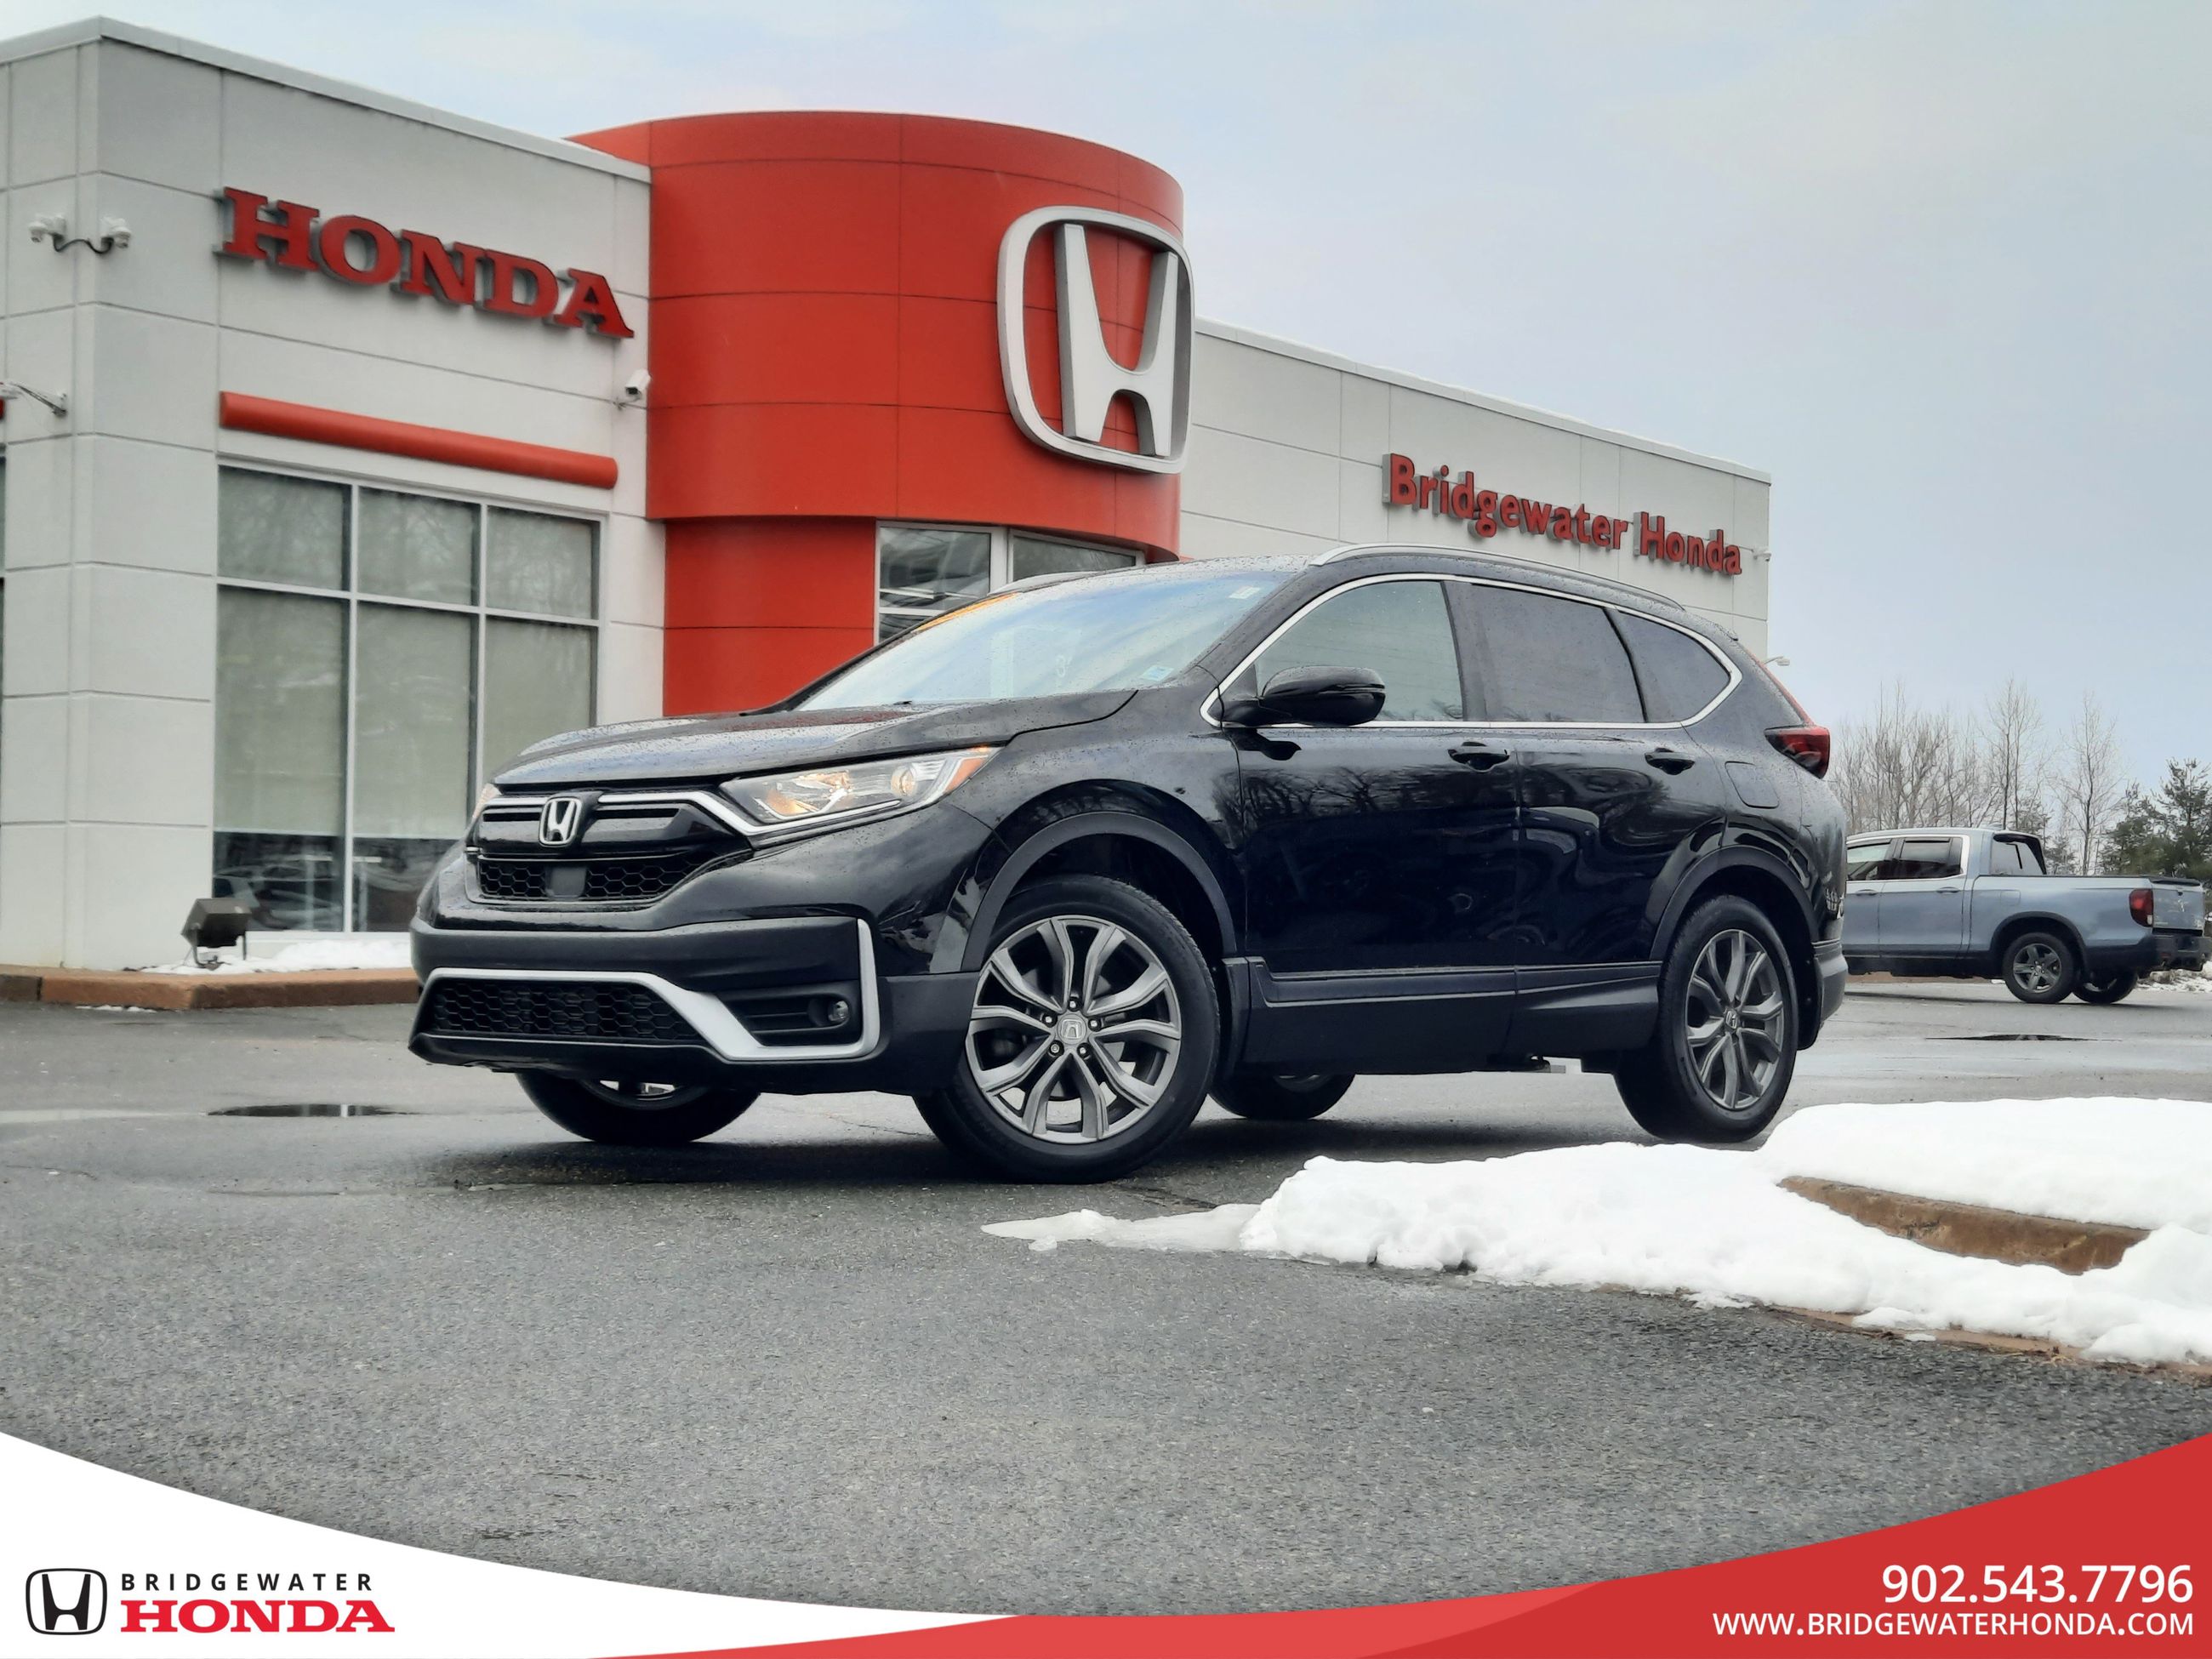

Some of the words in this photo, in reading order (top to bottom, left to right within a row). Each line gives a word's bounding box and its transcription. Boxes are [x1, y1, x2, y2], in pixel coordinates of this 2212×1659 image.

[221, 185, 635, 339] HONDA
[1388, 453, 1628, 550] Bridgewater
[1638, 510, 1742, 575] Honda
